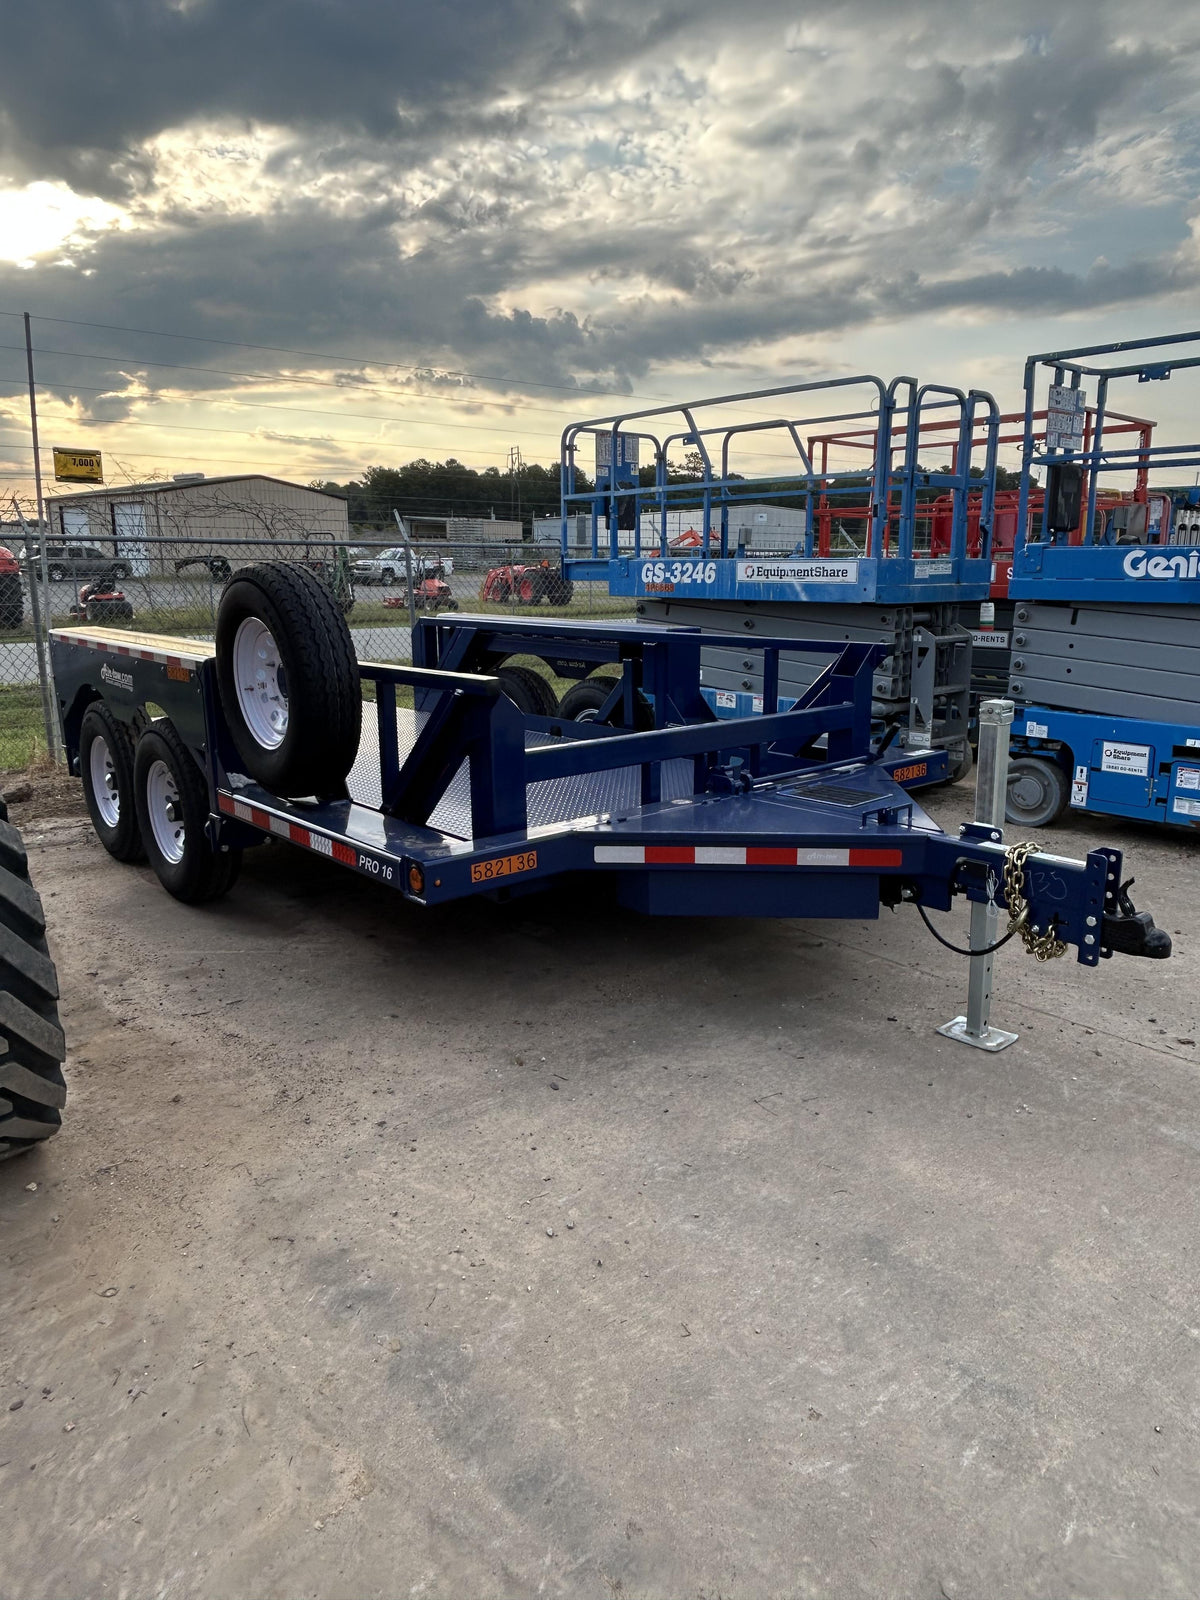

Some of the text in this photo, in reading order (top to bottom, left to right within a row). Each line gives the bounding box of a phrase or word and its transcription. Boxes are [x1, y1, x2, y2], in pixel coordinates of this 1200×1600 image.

[72, 458, 94, 467] 7,000
[641, 562, 716, 584] GS-3246
[756, 566, 848, 579] EquipmentShare
[1123, 549, 1200, 577] Geni
[1113, 749, 1147, 758] Equipment
[894, 764, 927, 782] 582136
[359, 855, 393, 880] PRO 16
[473, 852, 537, 882] 582136
